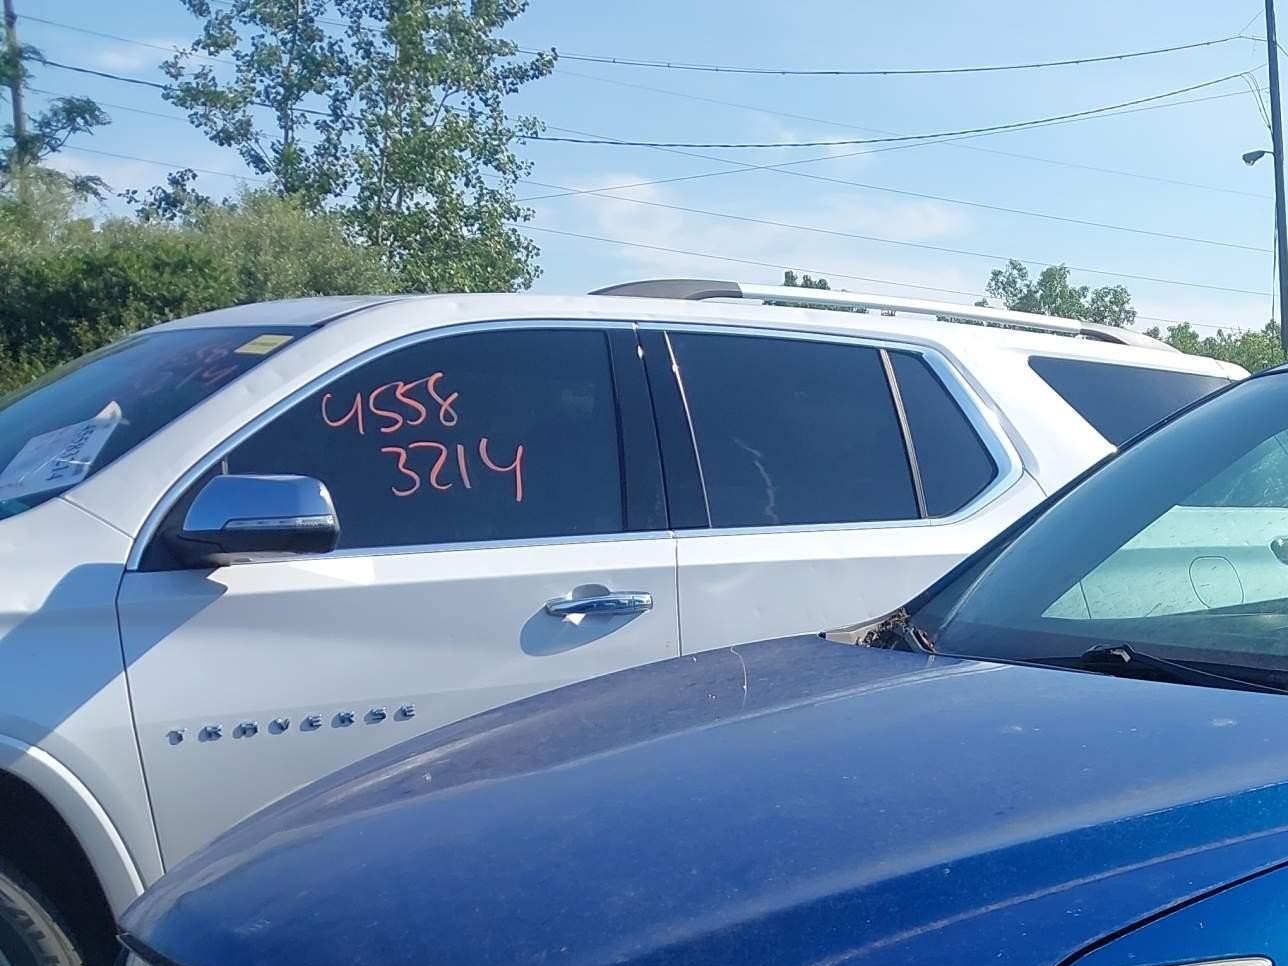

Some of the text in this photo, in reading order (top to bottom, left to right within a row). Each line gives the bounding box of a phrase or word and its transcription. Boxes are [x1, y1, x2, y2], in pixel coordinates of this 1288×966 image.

[322, 372, 458, 434] 4558
[381, 437, 523, 502] 3214
[166, 704, 415, 745] TRAVERSE
